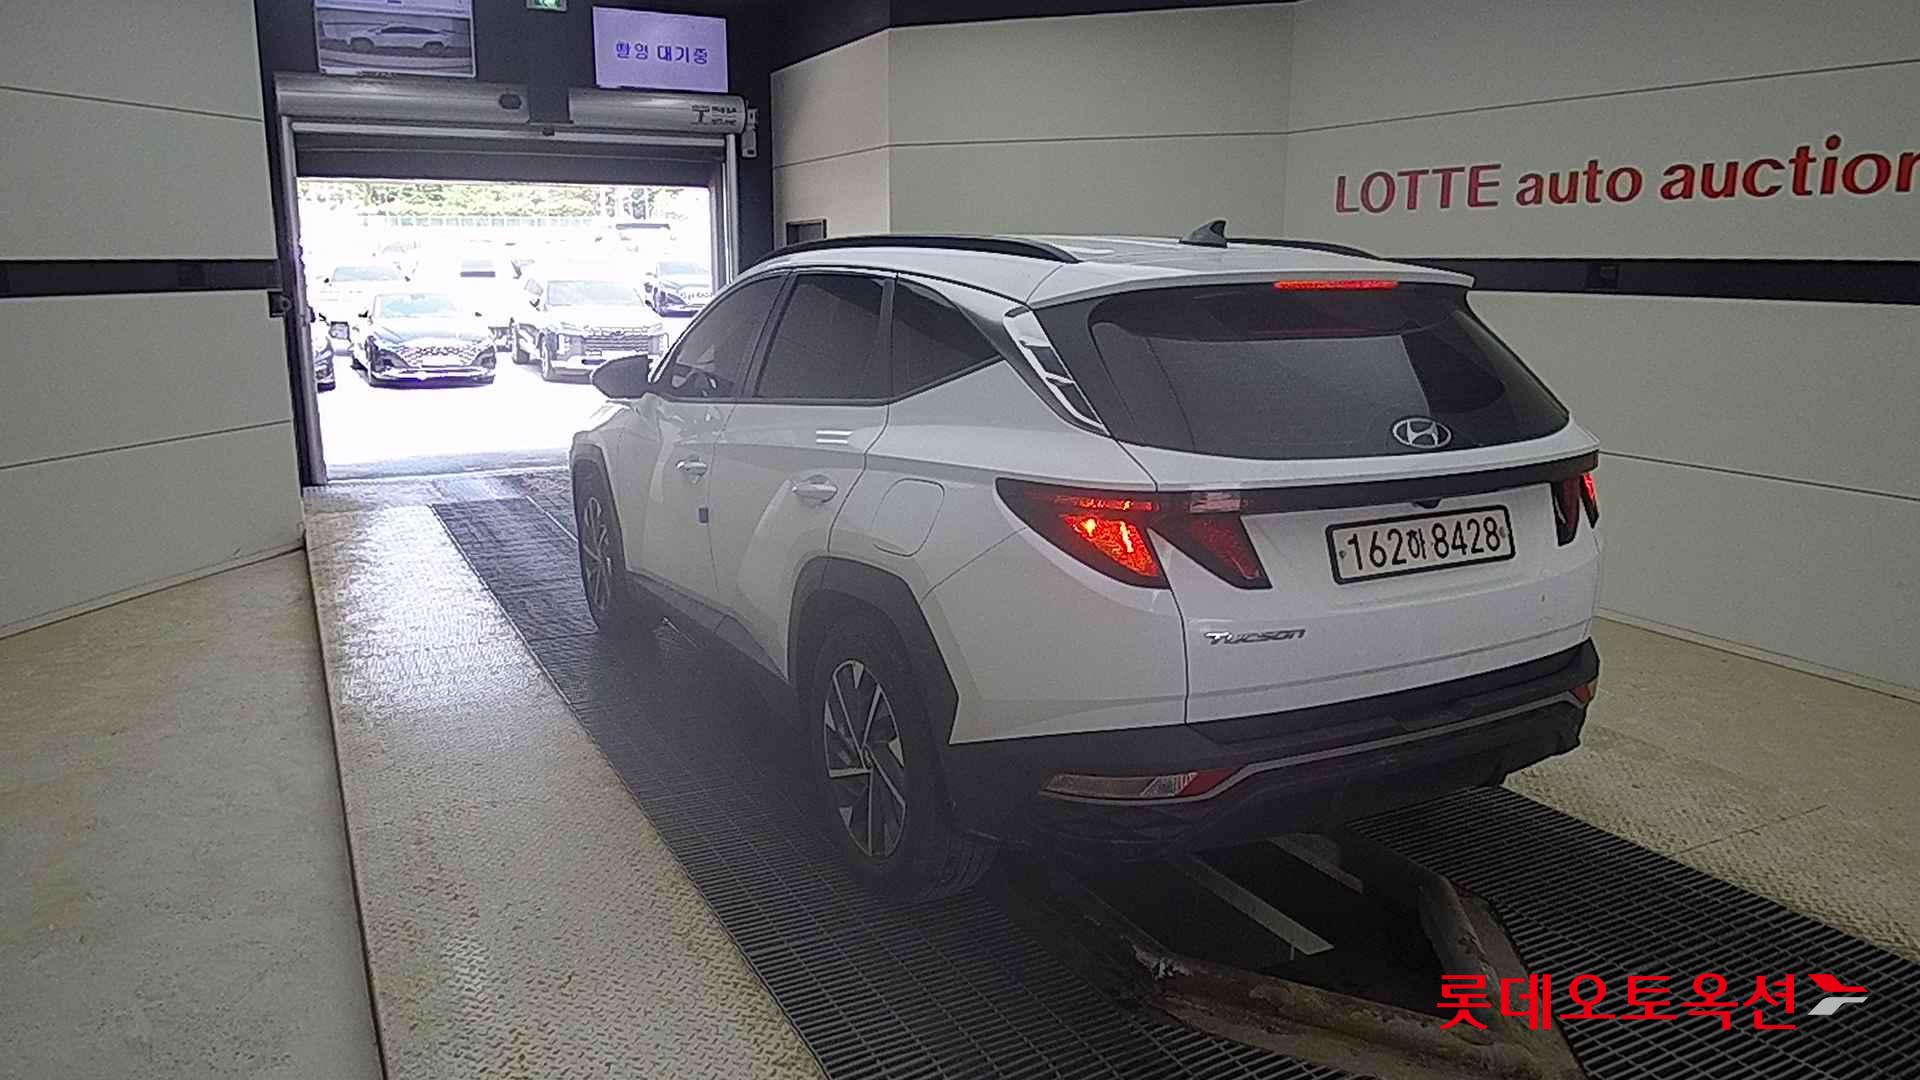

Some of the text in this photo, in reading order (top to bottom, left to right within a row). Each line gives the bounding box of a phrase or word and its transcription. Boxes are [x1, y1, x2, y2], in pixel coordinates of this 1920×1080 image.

[656, 44, 709, 66] 대기중
[1335, 164, 1502, 213] LOTTE
[1515, 158, 1643, 206] auto
